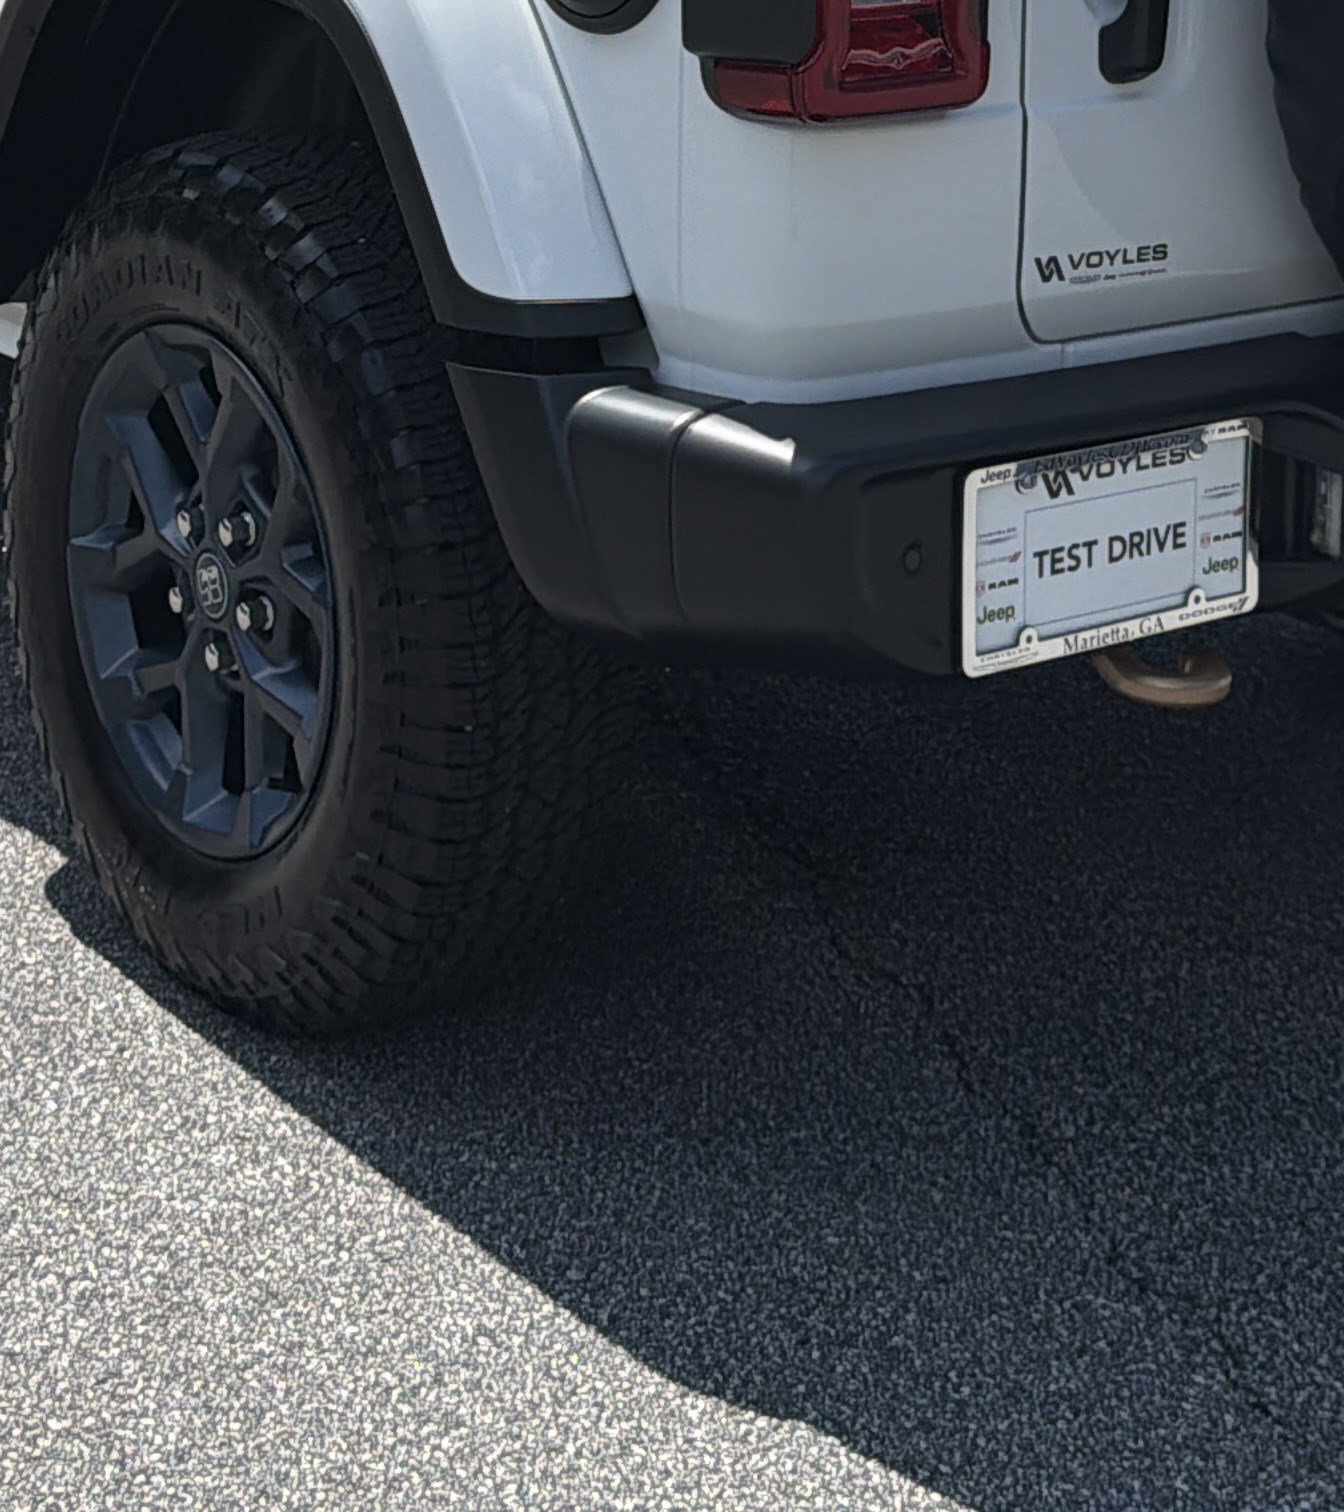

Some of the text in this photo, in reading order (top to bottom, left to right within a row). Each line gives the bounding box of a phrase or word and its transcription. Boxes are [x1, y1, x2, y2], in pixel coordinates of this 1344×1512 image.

[1067, 243, 1168, 270] VOYLES
[1078, 445, 1186, 482] VOYLES
[980, 469, 1011, 484] Jeep
[1032, 521, 1187, 579] TEST DRIVE
[1202, 556, 1239, 575] Jeep
[976, 605, 1015, 625] Jeep
[1139, 617, 1165, 636] GA
